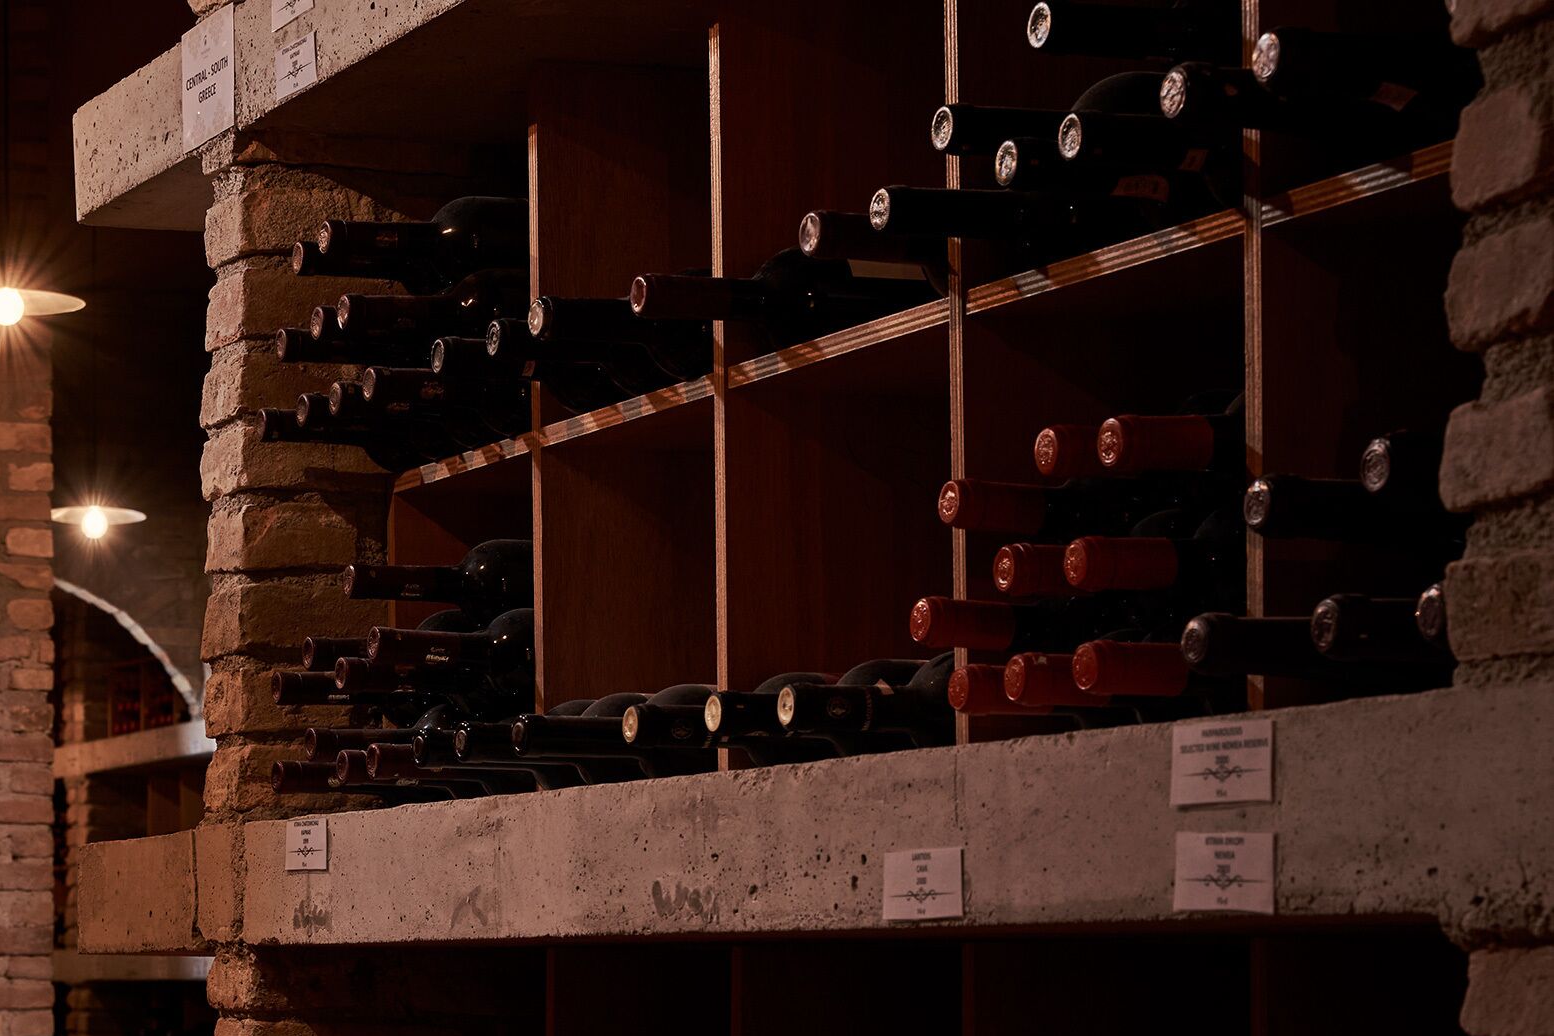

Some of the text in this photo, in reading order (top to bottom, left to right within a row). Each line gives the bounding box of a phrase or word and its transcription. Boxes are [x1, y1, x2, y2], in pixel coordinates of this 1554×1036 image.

[186, 69, 207, 91] CENTRAL
[210, 56, 228, 76] SOUTH
[198, 82, 216, 104] GREECE
